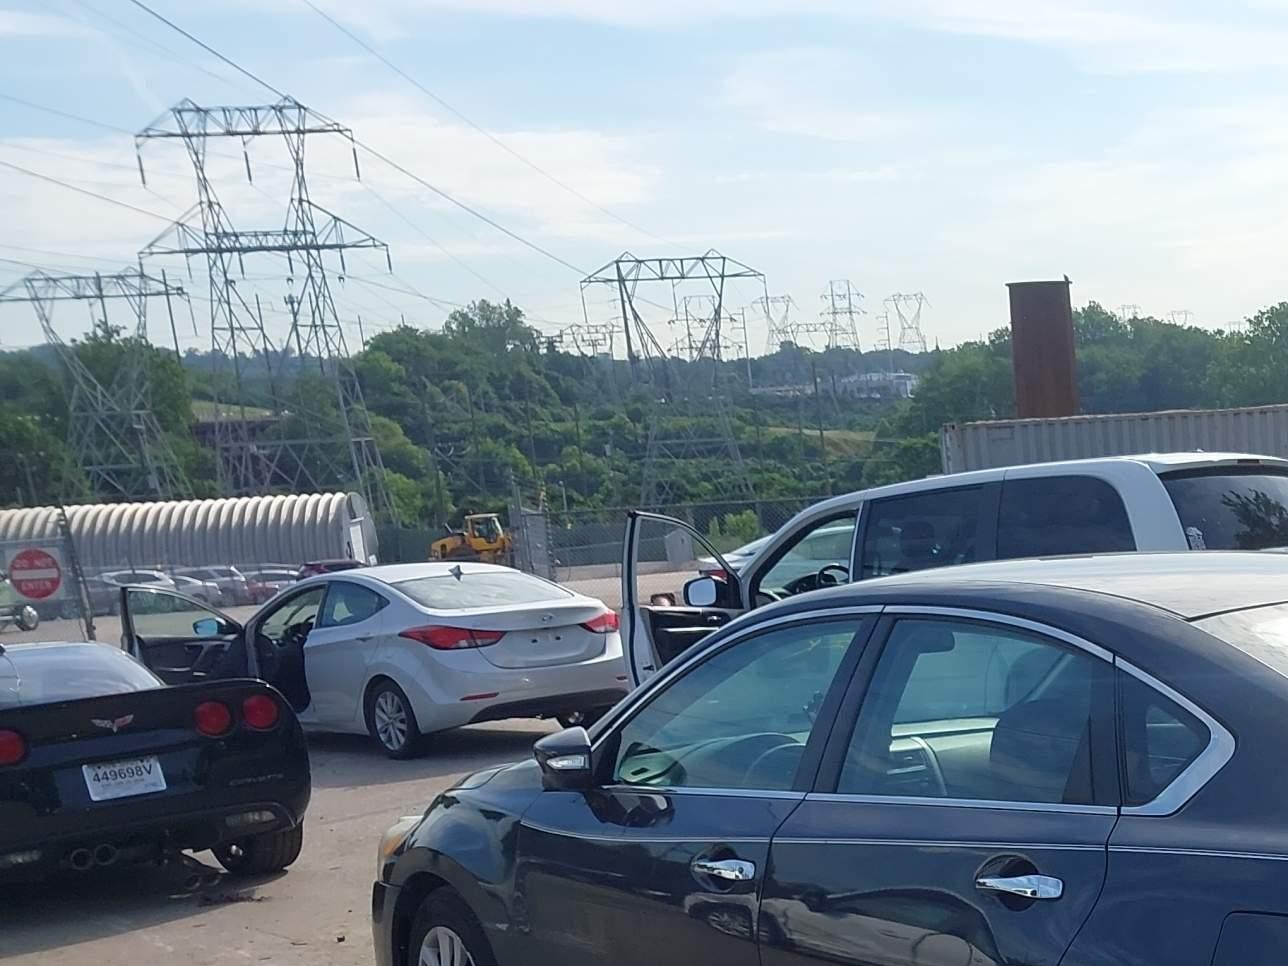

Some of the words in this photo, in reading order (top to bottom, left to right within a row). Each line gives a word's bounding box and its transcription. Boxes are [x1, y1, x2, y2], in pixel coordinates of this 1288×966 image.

[15, 559, 29, 568] DO
[34, 558, 54, 568] NOT
[21, 580, 51, 591] ENTER
[93, 763, 152, 782] 449698V
